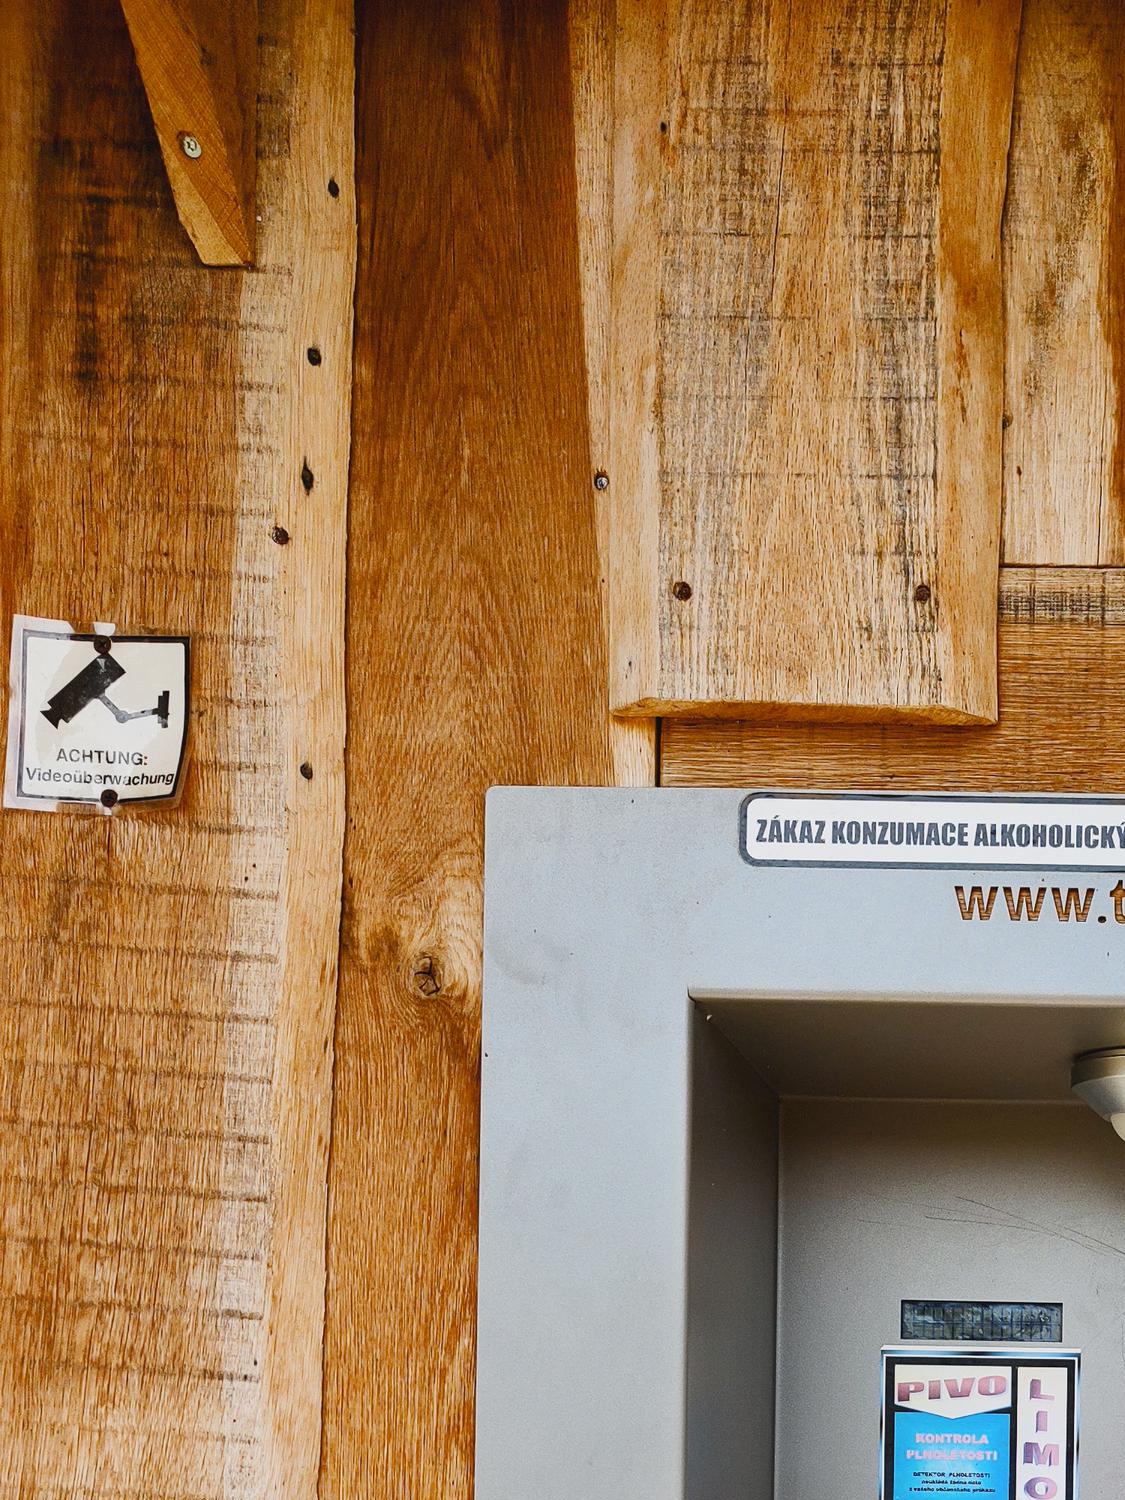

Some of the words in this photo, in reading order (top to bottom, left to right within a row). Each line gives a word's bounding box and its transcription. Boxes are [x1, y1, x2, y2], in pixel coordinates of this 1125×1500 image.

[56, 748, 148, 766] ACHTUNG:
[25, 767, 174, 786] Videoüberwachung
[756, 815, 825, 843] ZÁKAZ
[832, 820, 969, 847] KONZUMACE
[898, 1375, 1007, 1402] PIVO
[915, 1433, 989, 1445] KONTROLA
[1023, 1378, 1060, 1500] LIMO
[906, 1450, 998, 1461] PLNOLETOSTI
